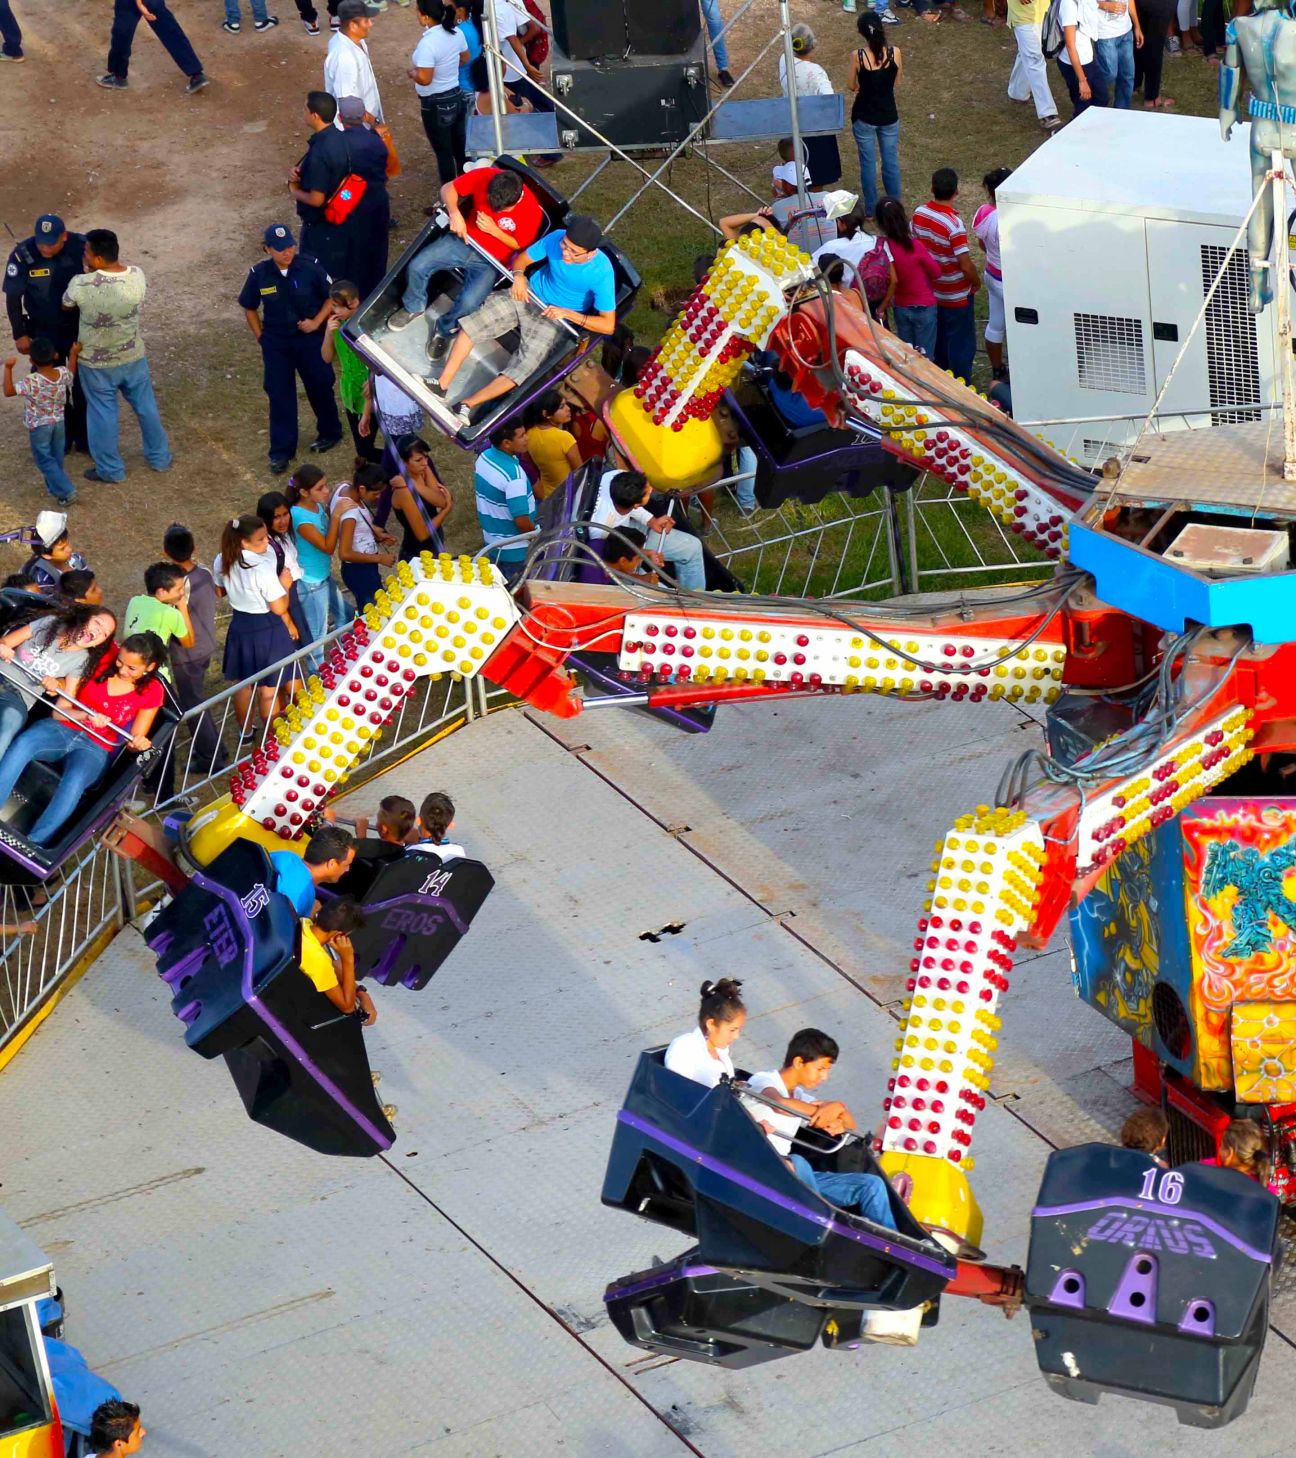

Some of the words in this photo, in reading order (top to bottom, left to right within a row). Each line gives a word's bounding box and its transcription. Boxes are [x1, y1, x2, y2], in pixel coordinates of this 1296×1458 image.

[417, 869, 453, 897] 14
[240, 883, 270, 918] 15
[380, 908, 444, 936] EROS
[1138, 1167, 1185, 1205] 16
